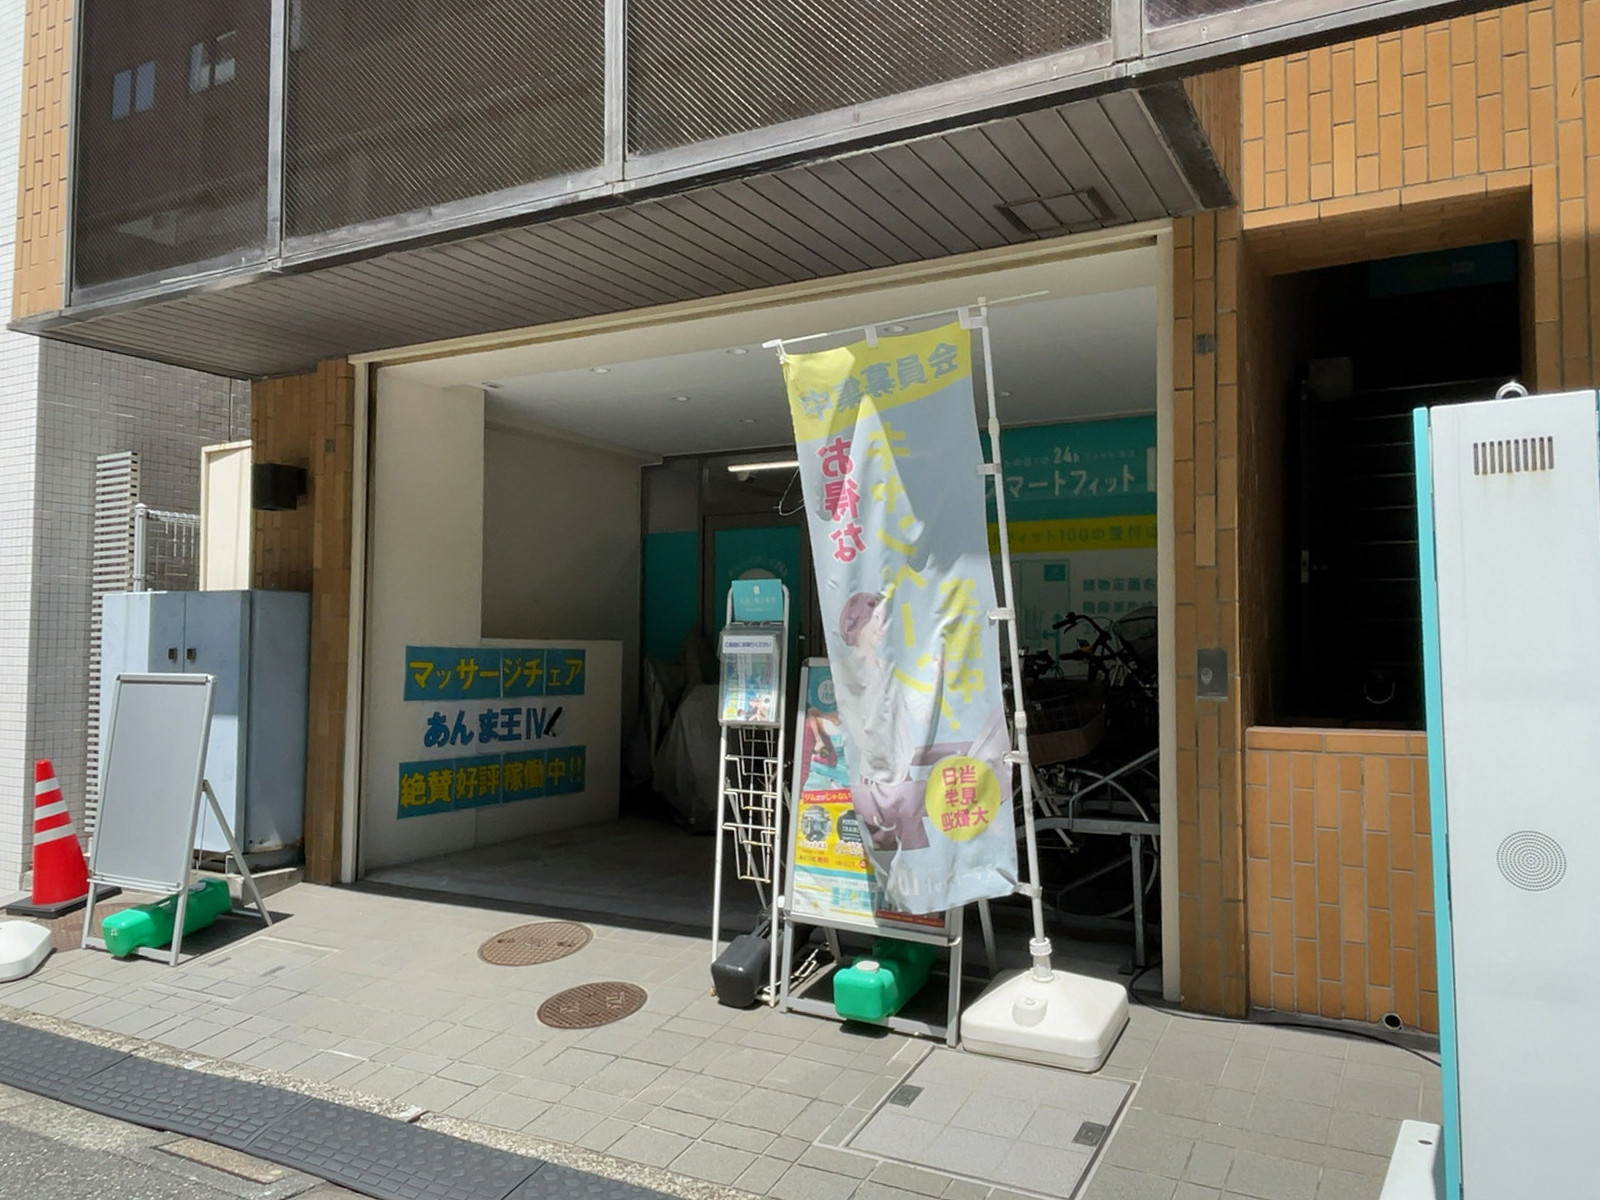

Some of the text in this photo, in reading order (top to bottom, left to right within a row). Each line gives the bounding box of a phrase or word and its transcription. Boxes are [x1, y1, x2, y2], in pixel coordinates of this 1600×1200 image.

[409, 658, 584, 690] マッサージチェア
